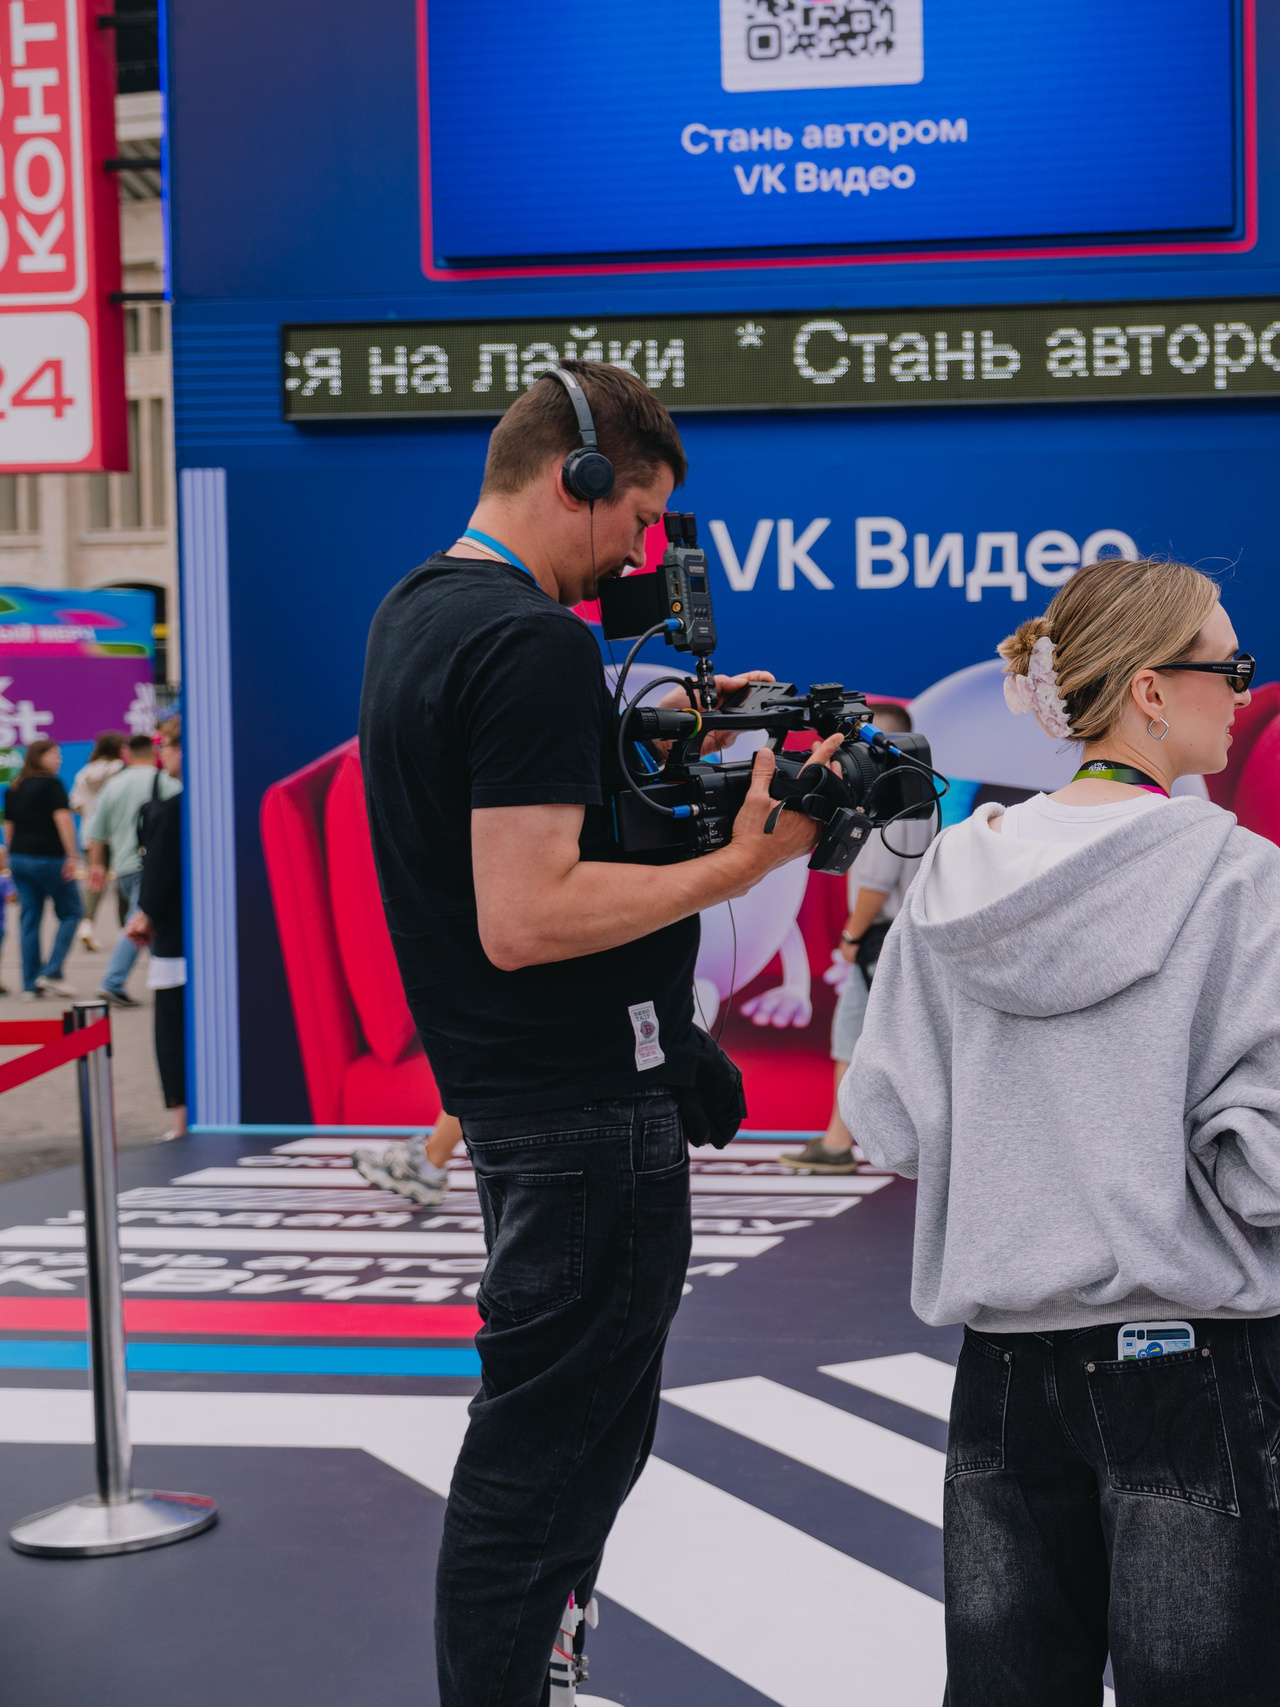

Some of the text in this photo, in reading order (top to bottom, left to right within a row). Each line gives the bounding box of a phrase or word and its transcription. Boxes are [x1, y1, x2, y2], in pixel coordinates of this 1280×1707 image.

[681, 118, 968, 155] Стань автором
[733, 161, 917, 197] VK Видео
[368, 345, 452, 394] на
[793, 320, 1021, 384] Стань
[0, 358, 75, 420] 4
[709, 518, 835, 592] VK
